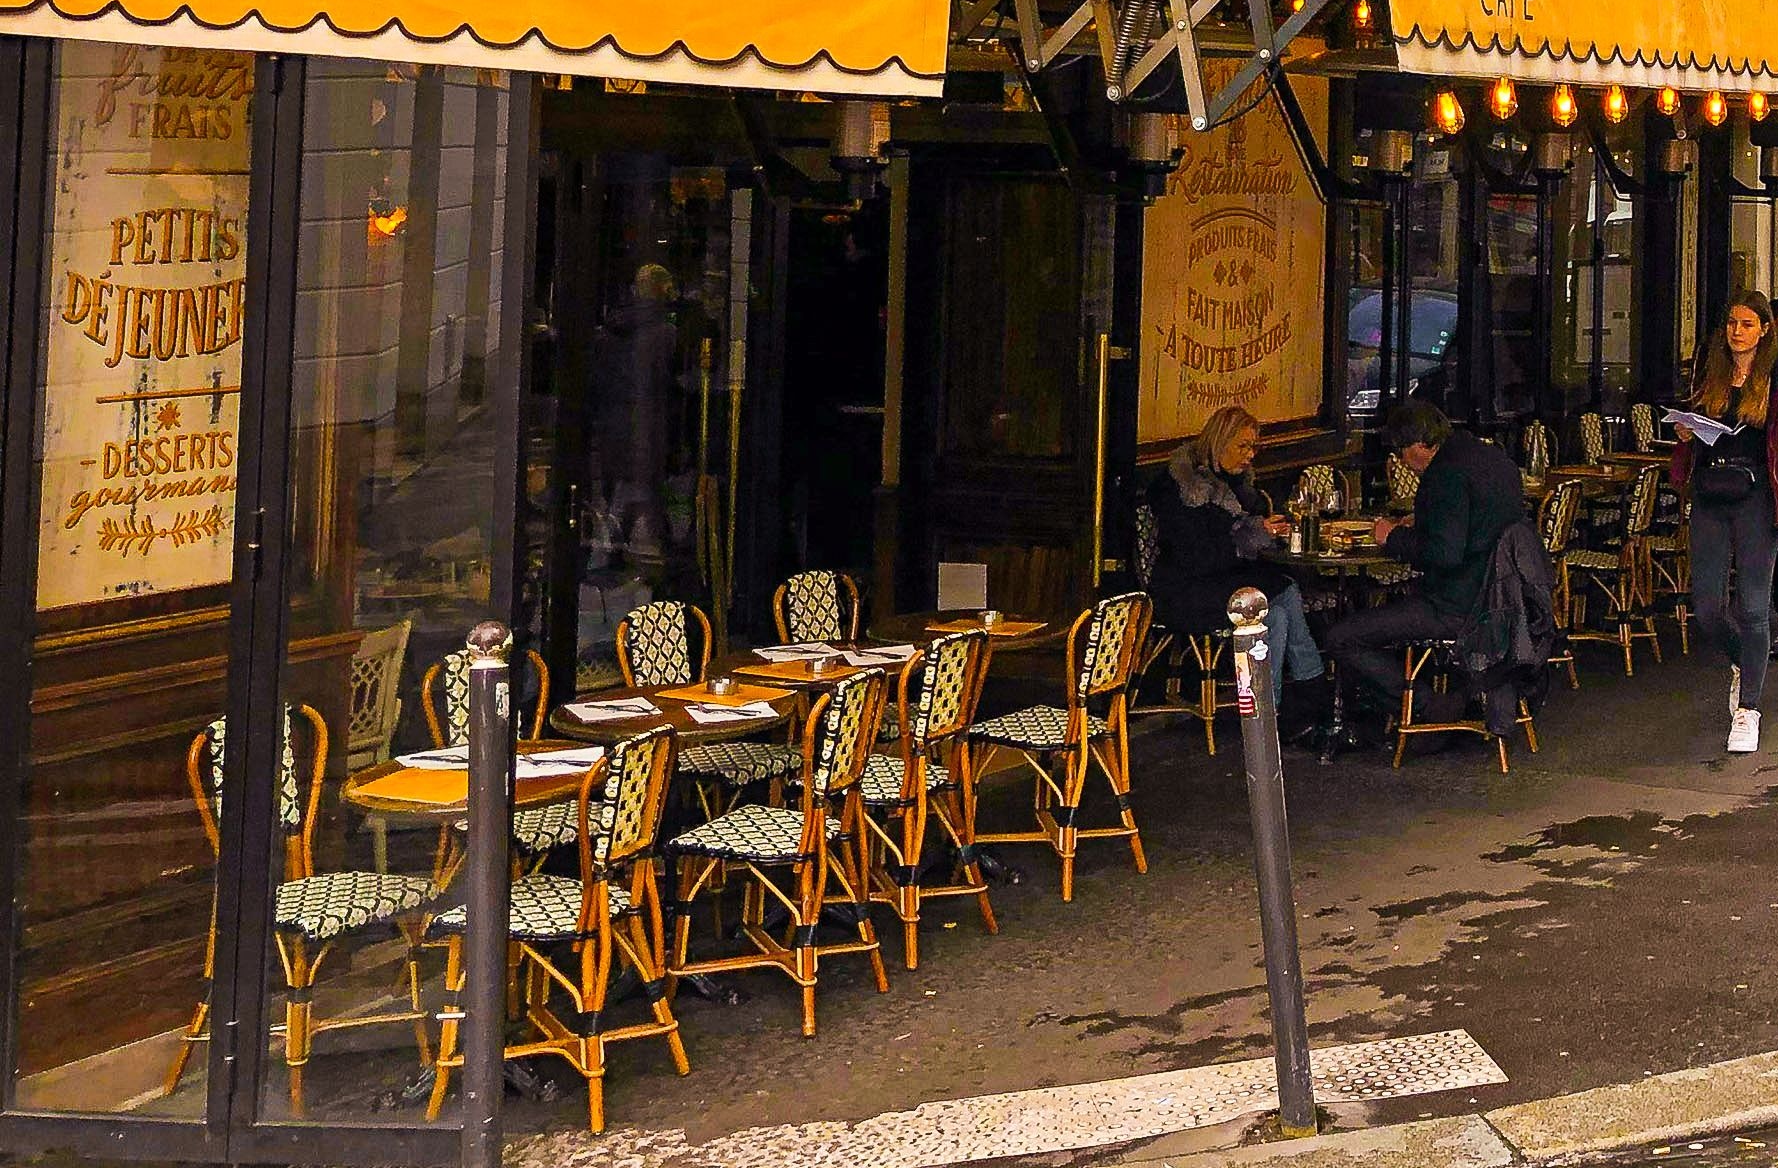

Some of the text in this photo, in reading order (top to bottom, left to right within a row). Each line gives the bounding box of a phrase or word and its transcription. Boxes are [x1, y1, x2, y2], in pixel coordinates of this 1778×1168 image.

[127, 102, 233, 140] FRAIS
[109, 207, 239, 266] PETITS
[1187, 225, 1278, 271] PRODUITS FRAIS
[1227, 258, 1240, 288] &
[1187, 281, 1275, 330] FAIT MAISON
[1181, 332, 1237, 374] TOUTE
[1239, 311, 1292, 369] HEURE
[102, 431, 234, 480] DESSERTS
